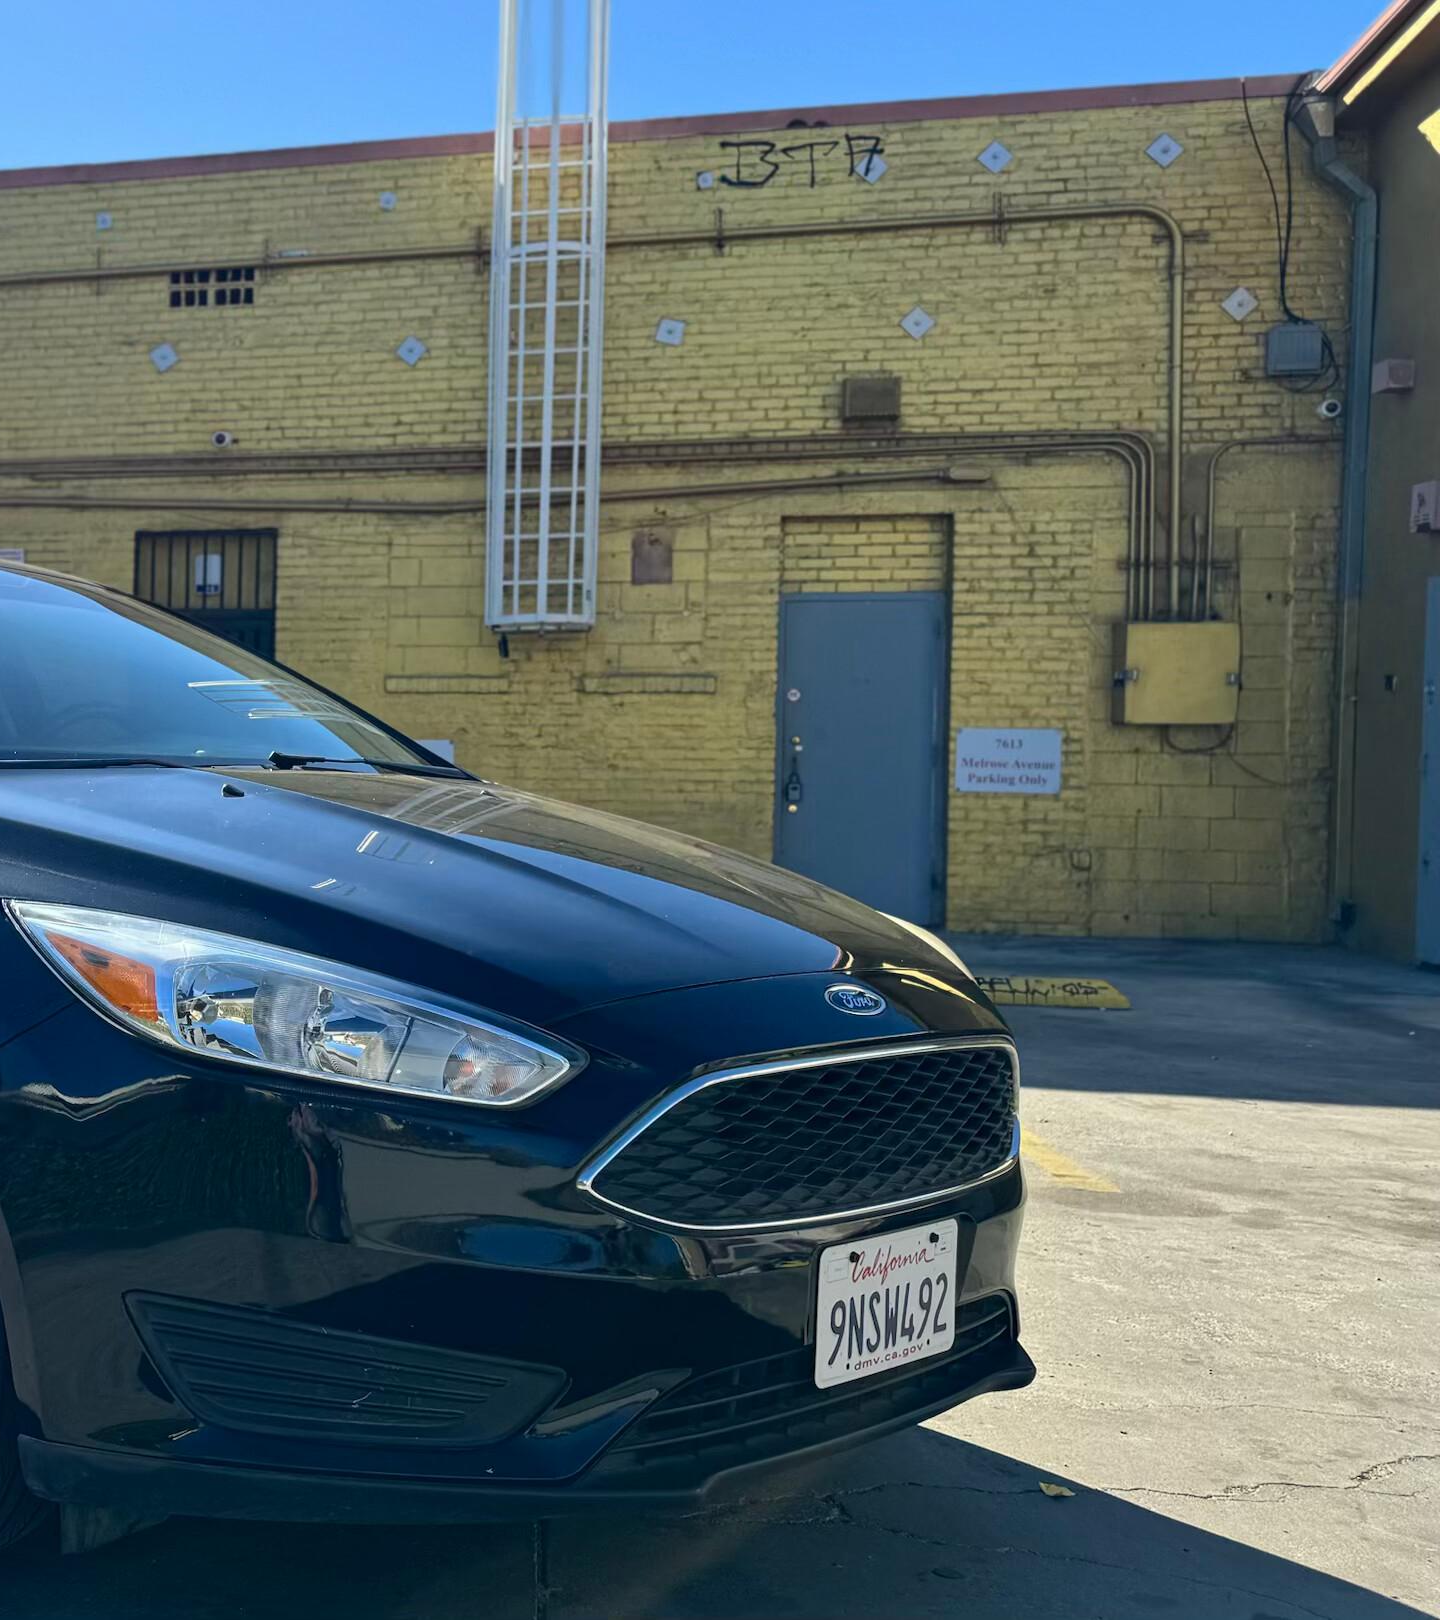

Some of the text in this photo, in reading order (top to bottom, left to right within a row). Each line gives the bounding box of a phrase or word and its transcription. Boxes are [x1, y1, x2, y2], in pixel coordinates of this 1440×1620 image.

[994, 738, 1024, 750] 7613
[961, 757, 1056, 770] Melrose Avenue
[967, 772, 1048, 786] Parking Only
[838, 991, 875, 1009] Ford
[851, 1245, 935, 1286] California
[827, 1272, 949, 1366] 9NSW492
[854, 1342, 924, 1371] dmv.ca.gov
